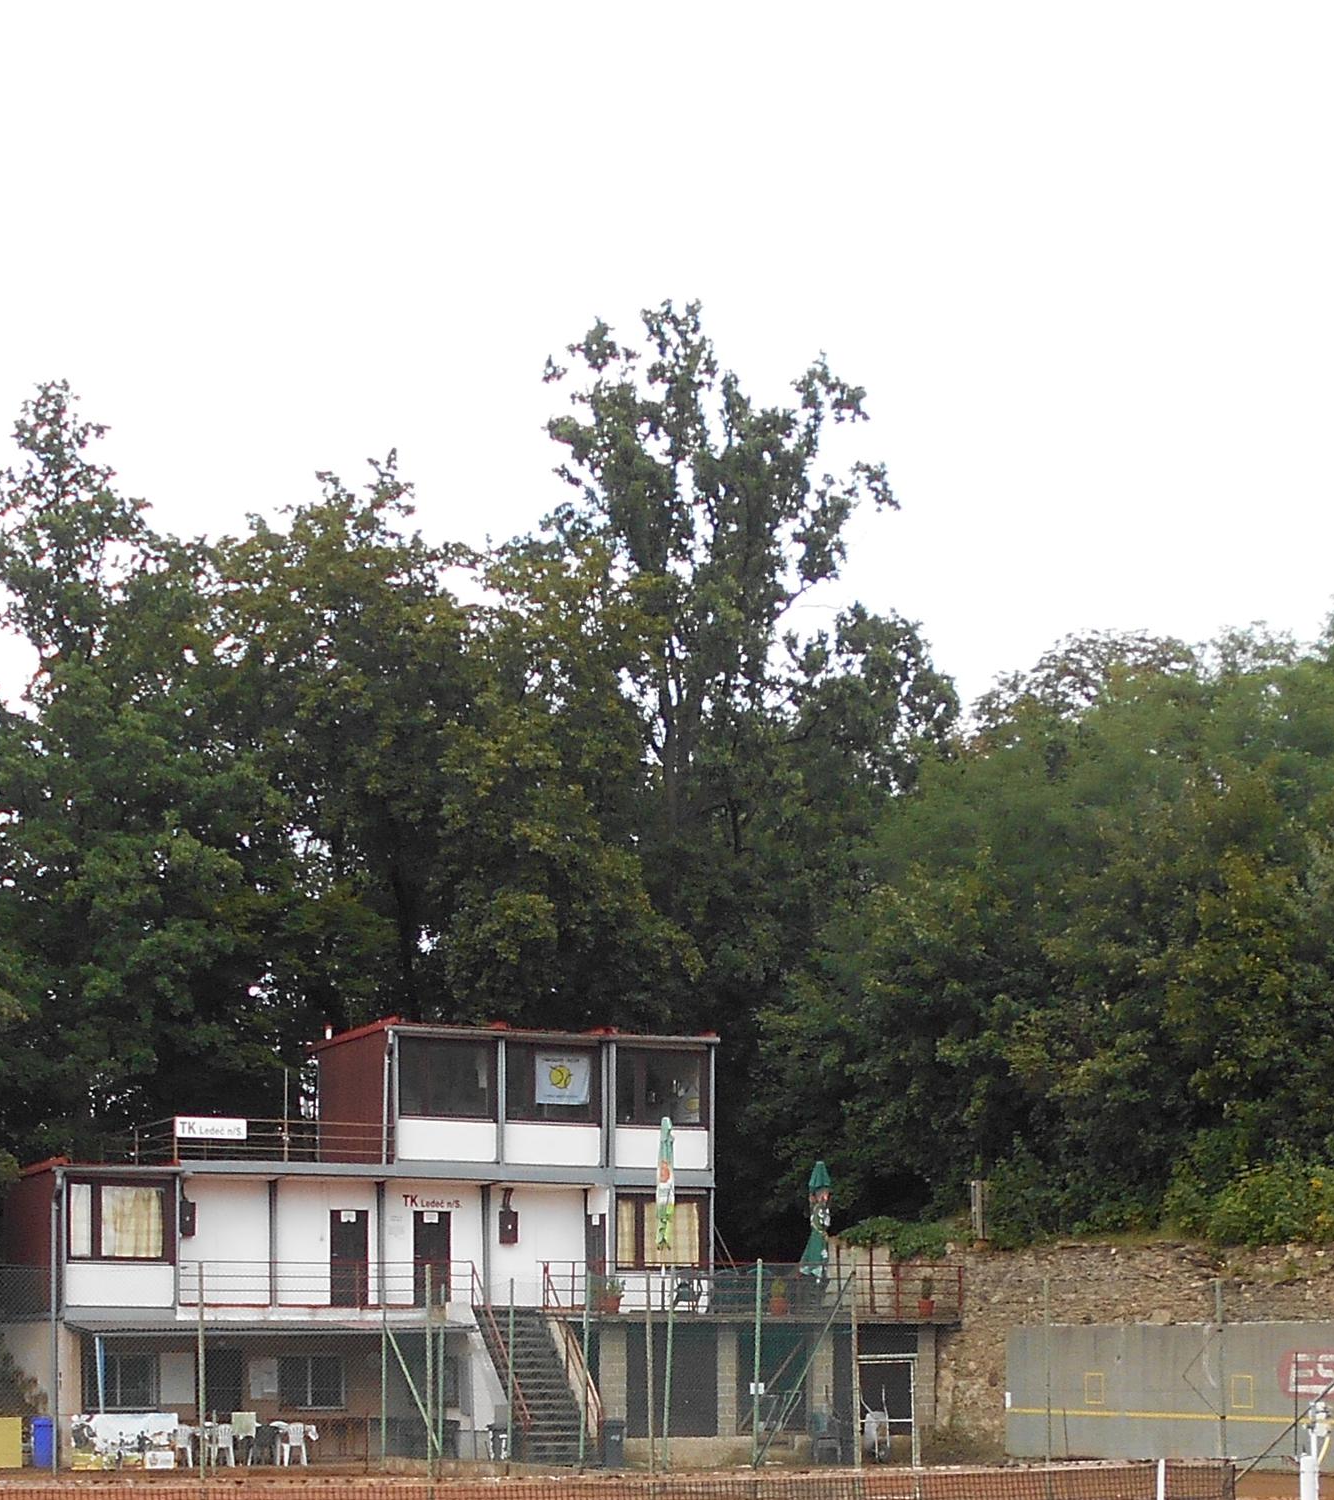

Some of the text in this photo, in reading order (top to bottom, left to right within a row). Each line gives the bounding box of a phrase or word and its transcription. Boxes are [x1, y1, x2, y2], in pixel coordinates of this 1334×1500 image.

[179, 1121, 196, 1135] TK
[199, 1126, 224, 1136] Ledeč
[402, 1194, 419, 1207] TK
[420, 1199, 445, 1208] Ledeč
